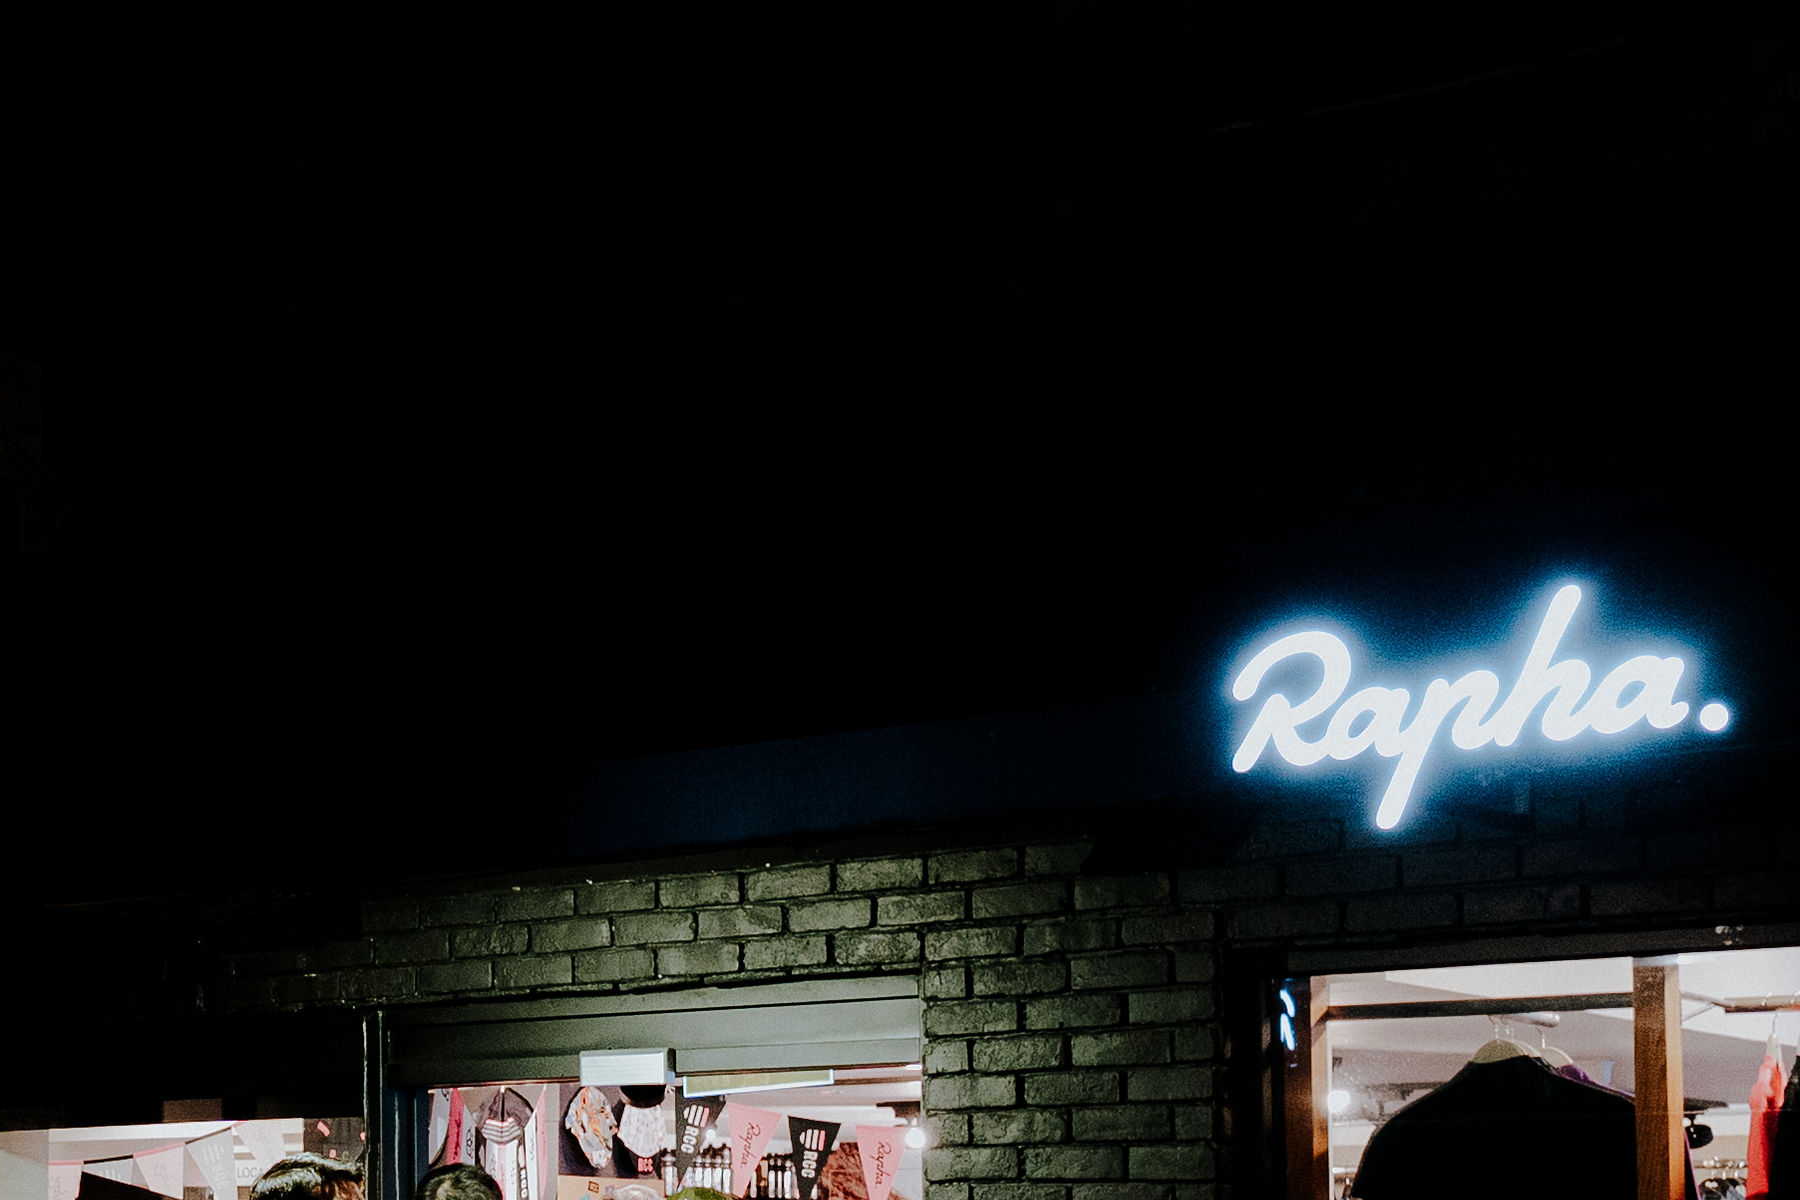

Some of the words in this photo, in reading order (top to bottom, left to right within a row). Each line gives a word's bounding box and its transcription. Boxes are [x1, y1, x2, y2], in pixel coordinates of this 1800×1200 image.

[1232, 584, 1729, 829] Rapha.
[681, 1125, 700, 1154] RCC
[802, 1150, 818, 1178] RCC
